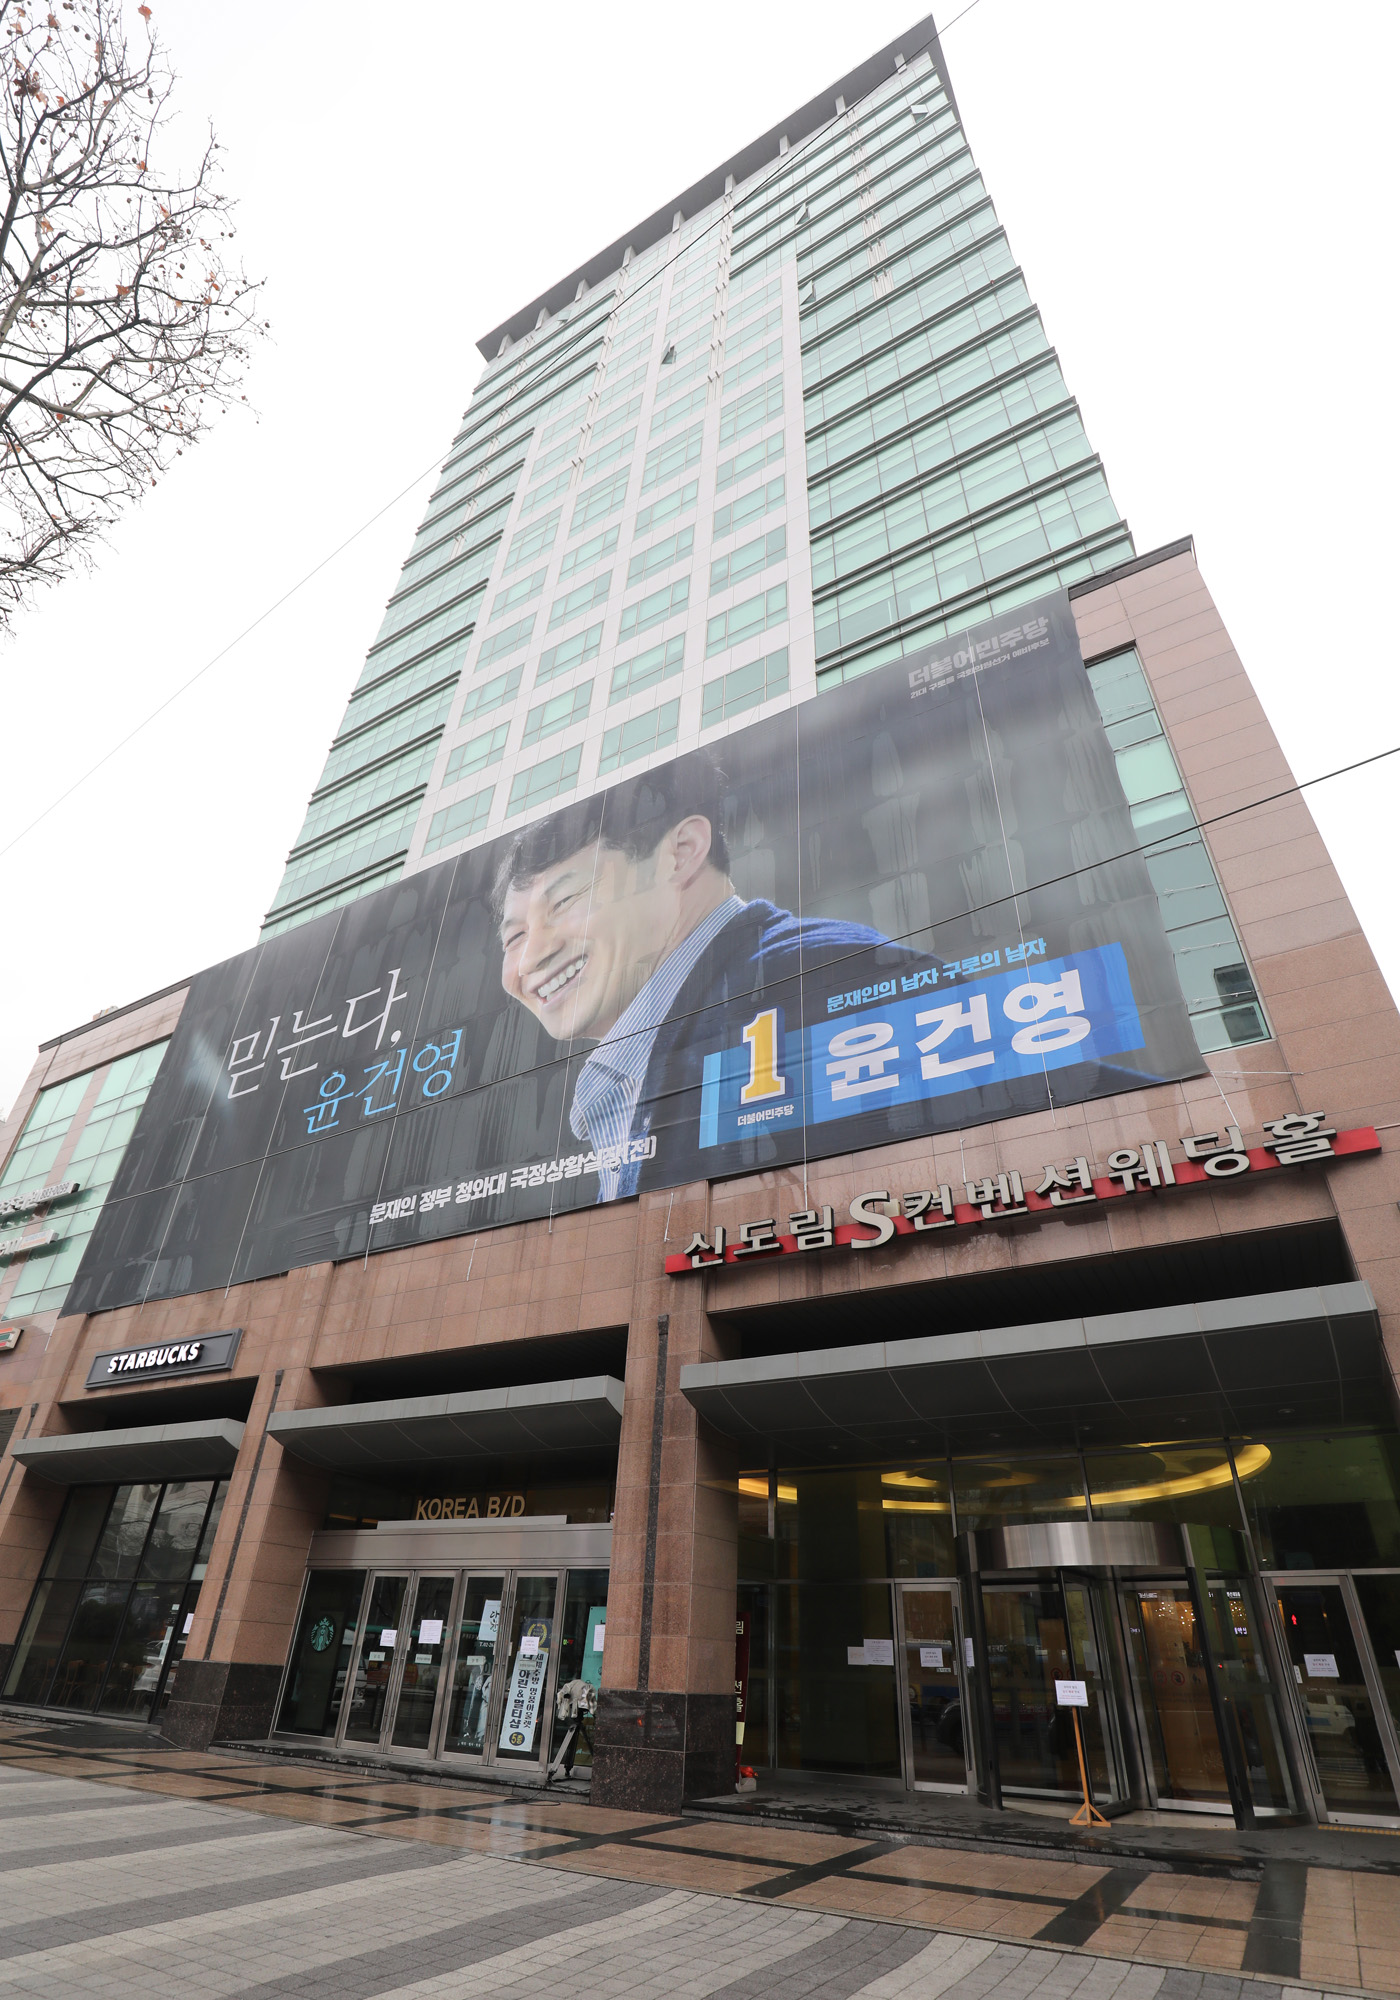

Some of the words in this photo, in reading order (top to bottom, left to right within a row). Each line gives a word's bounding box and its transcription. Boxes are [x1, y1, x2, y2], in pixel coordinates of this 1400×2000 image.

[908, 616, 1049, 688] 더불어민주당
[910, 688, 928, 699] 21대
[1012, 638, 1050, 658] 예비후보
[826, 979, 897, 1013] 문재인의
[901, 967, 940, 993] 남자
[942, 949, 1001, 980] 구로의
[1005, 937, 1048, 963] 남자
[740, 1007, 786, 1105] 1
[826, 968, 1092, 1102] 윤건영
[303, 1028, 463, 1134] 윤건영
[737, 1104, 795, 1126] 더불어민주당
[368, 1194, 417, 1225] 문재인
[419, 1186, 451, 1213] 정부
[455, 1171, 507, 1204] 청와대
[510, 1135, 658, 1190] 국정상황실장(전)
[107, 1342, 202, 1374] STARBUCKS
[415, 1497, 480, 1520] KOREA
[486, 1495, 526, 1518] B/D
